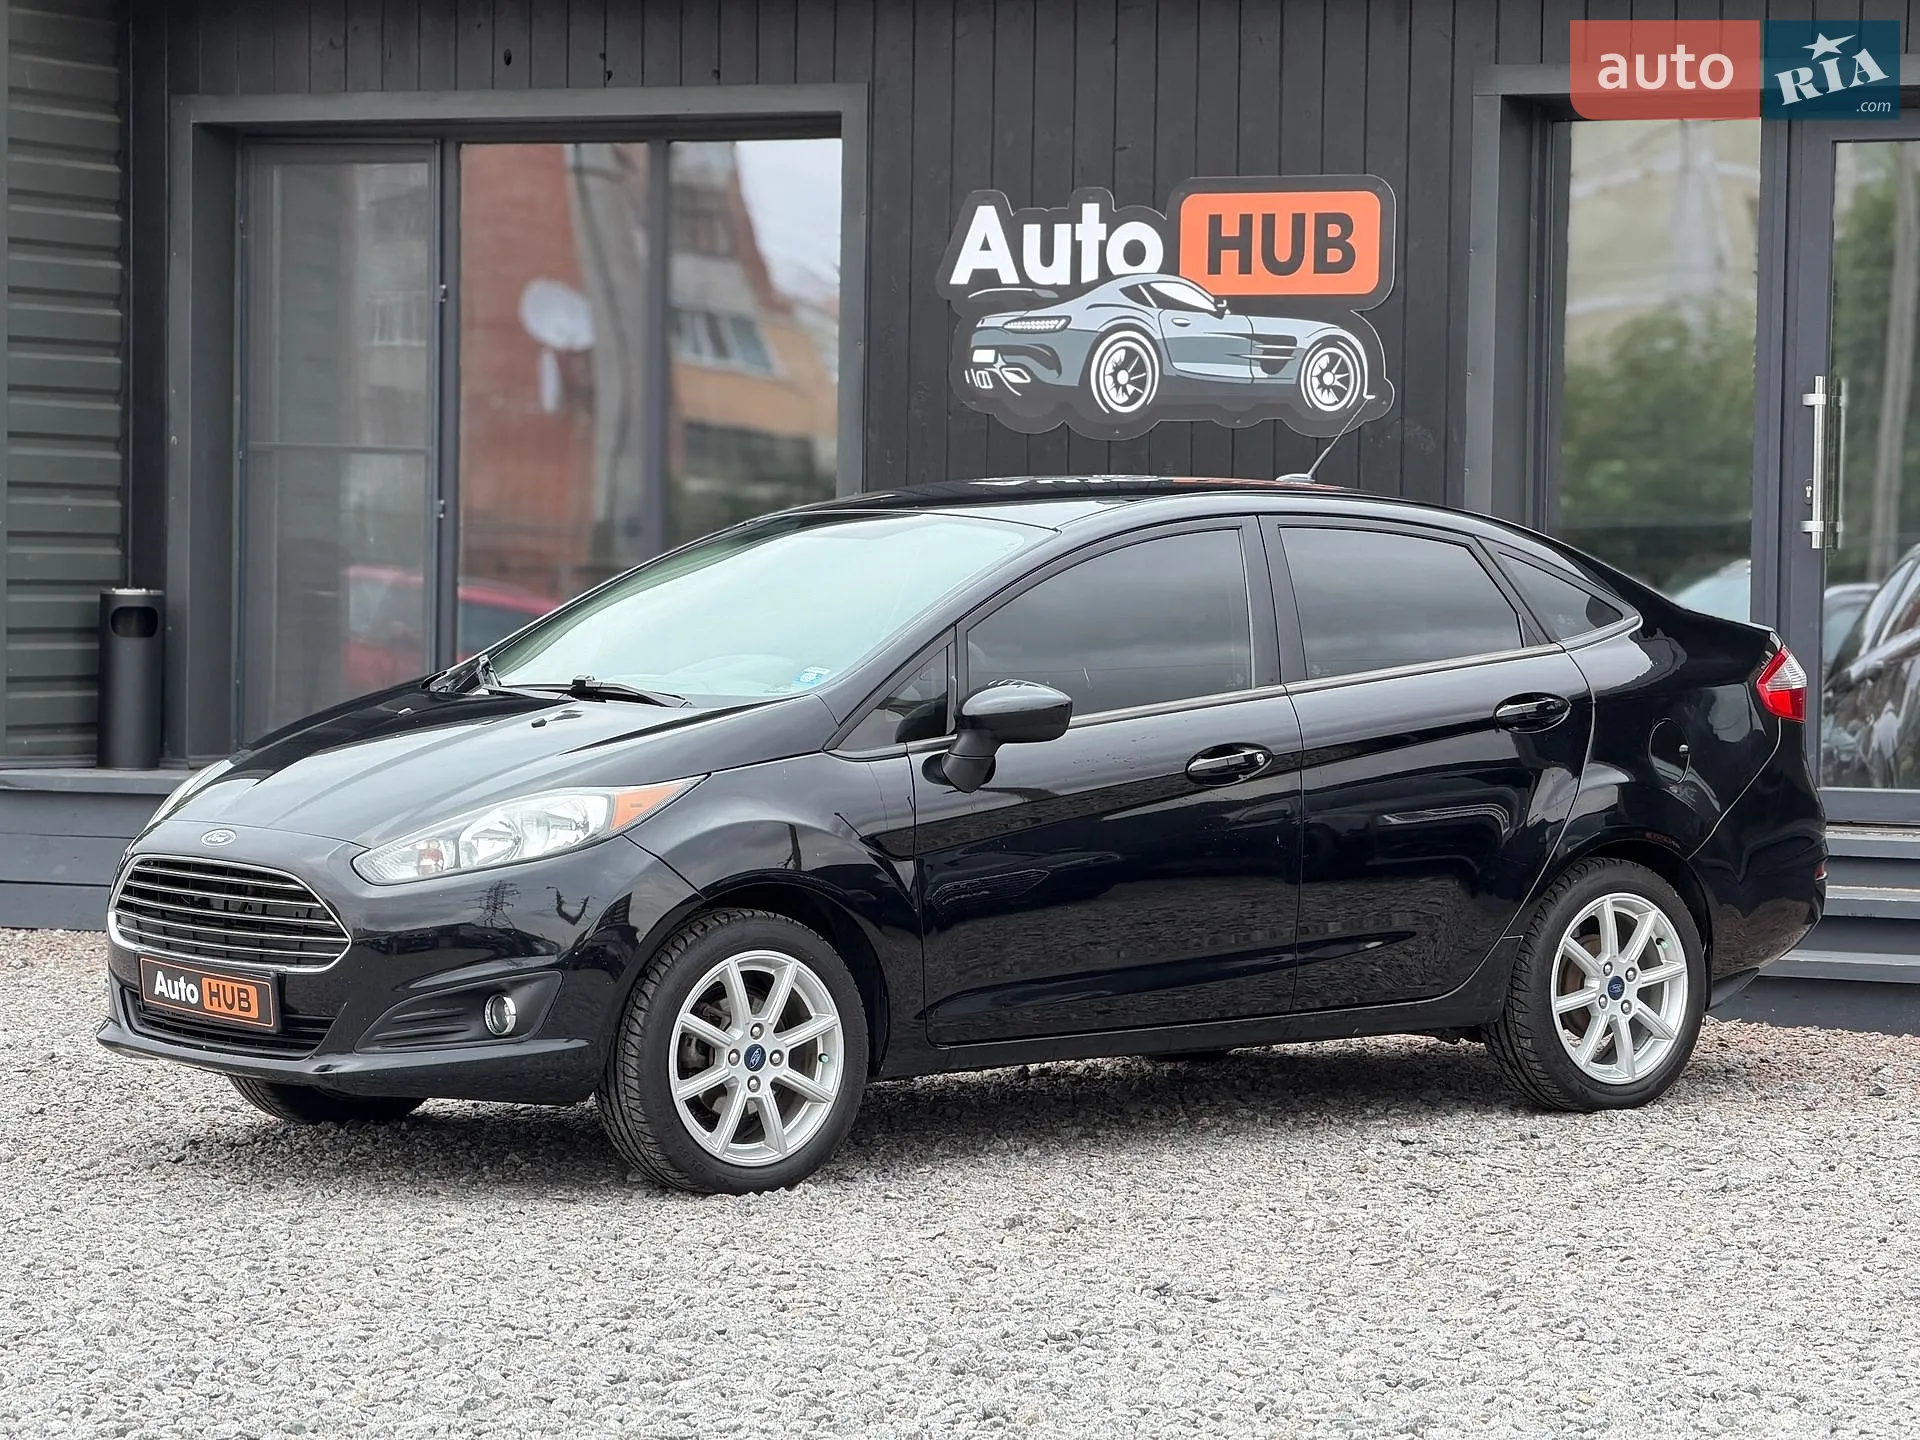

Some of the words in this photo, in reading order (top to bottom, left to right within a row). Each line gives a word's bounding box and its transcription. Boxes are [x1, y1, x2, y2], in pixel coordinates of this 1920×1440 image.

[949, 202, 1164, 286] Auto
[1207, 212, 1356, 277] HUB
[154, 970, 199, 1004] Auto
[207, 981, 252, 1012] HUB
